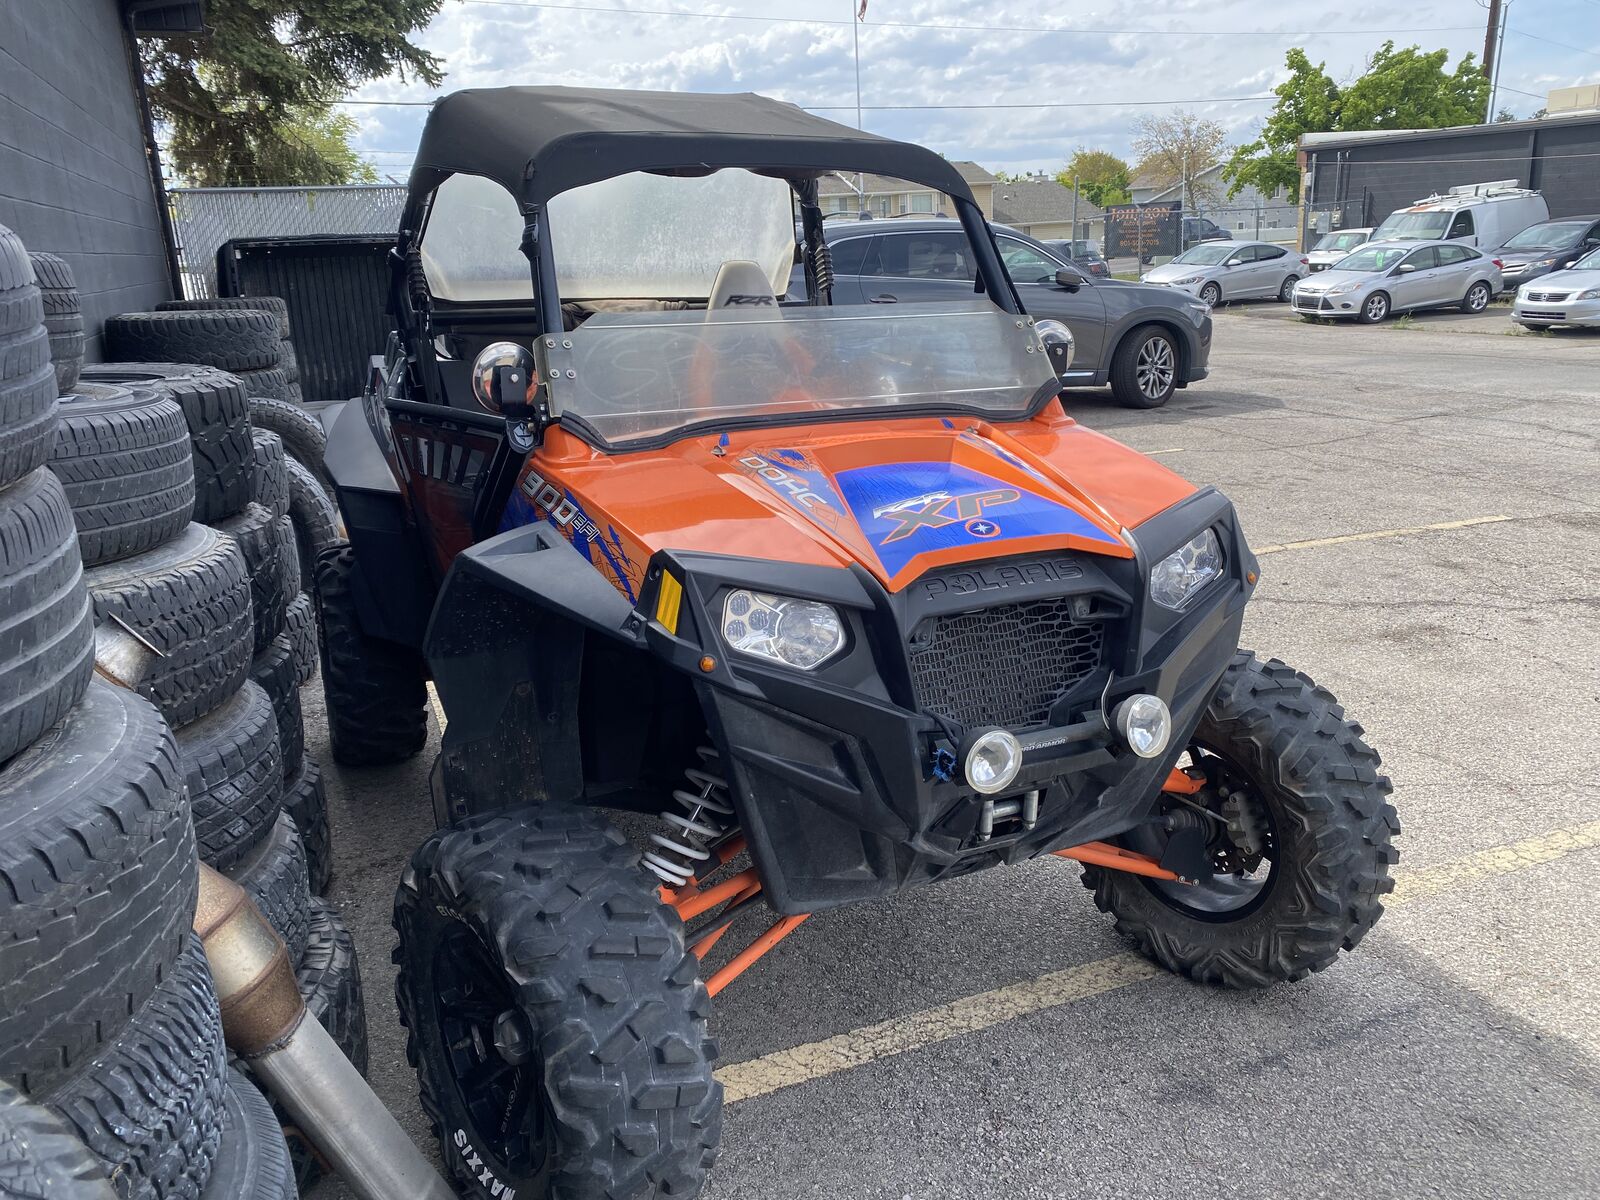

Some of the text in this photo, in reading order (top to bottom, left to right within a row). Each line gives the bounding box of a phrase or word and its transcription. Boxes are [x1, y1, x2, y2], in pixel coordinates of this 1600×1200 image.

[723, 294, 773, 307] RZR
[738, 456, 828, 508] DOHC
[879, 488, 1021, 546] XP
[920, 557, 1084, 601] POLARIS
[1036, 738, 1067, 749] ARMOR
[454, 1128, 516, 1200] MAXXIS
